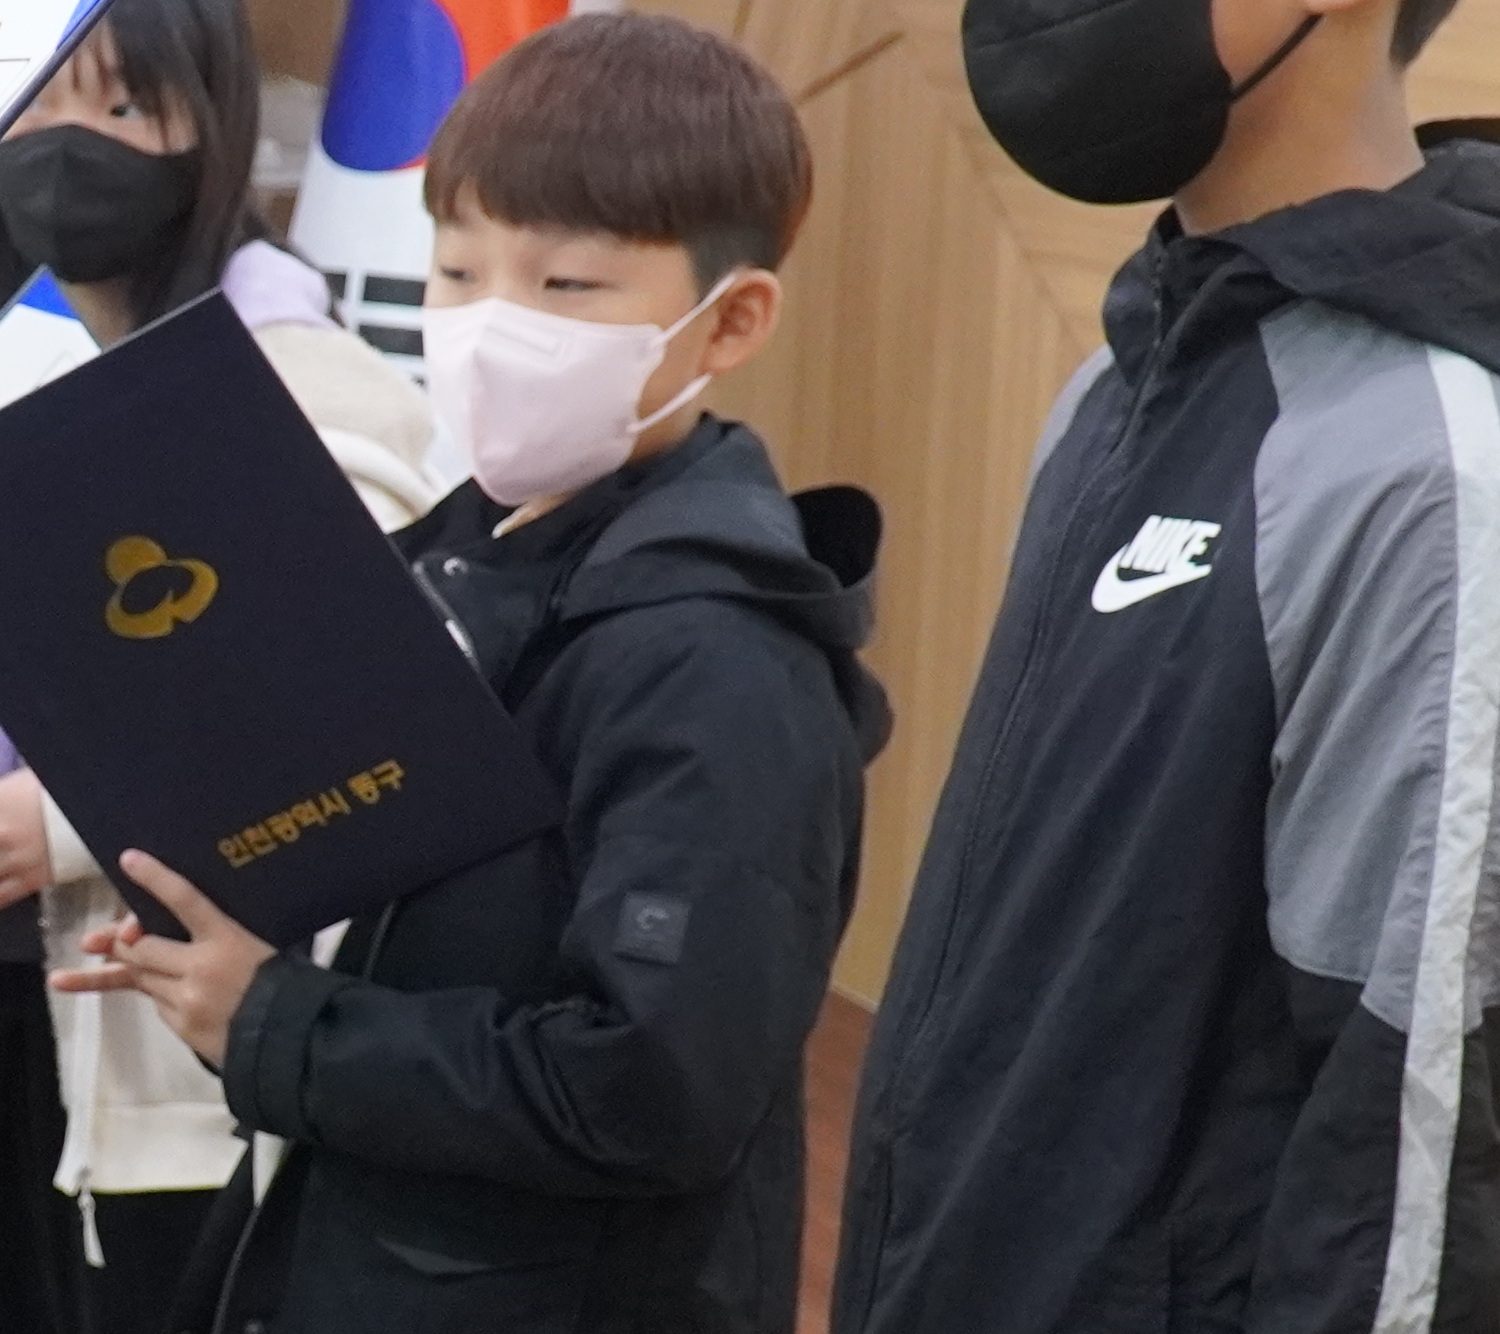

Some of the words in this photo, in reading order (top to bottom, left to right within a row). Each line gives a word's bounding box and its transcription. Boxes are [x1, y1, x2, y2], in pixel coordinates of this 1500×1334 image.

[1119, 514, 1222, 575] NIKE
[217, 787, 351, 868] 인천광역시
[348, 759, 405, 805] 동구
